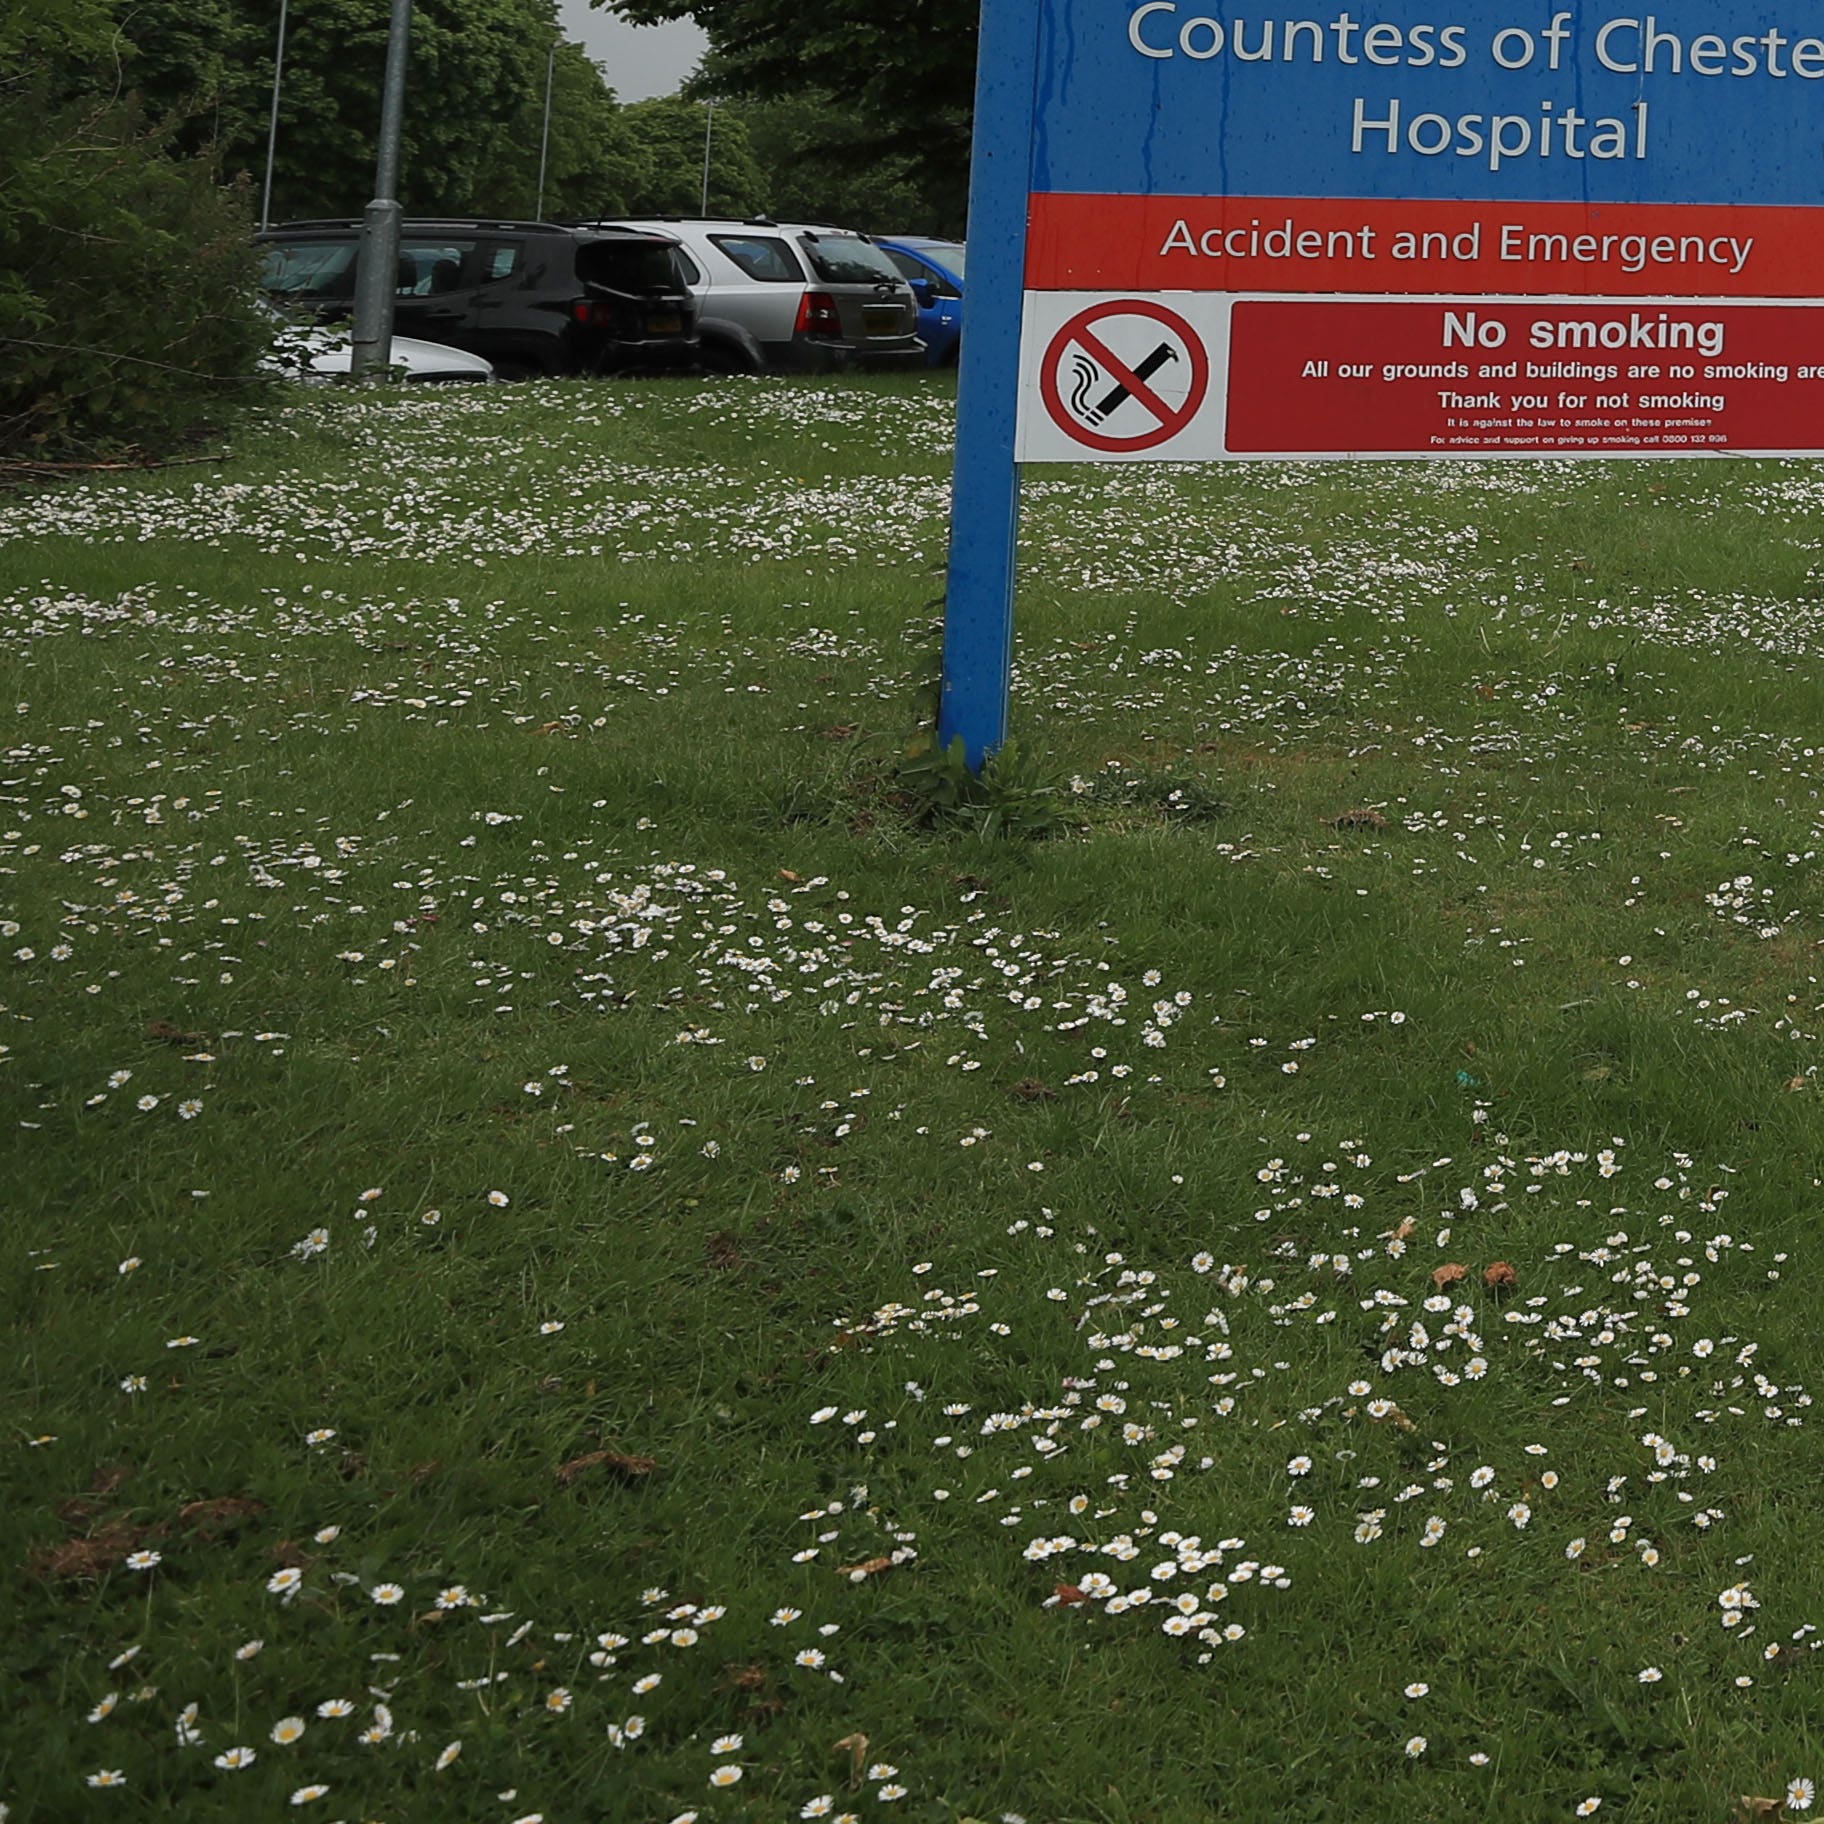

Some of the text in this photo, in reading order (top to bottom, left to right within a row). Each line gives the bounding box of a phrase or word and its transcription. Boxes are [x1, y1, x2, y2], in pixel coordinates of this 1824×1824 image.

[1128, 1, 1466, 67] Countess
[1492, 12, 1572, 69] of
[1352, 98, 1648, 171] Hospital
[1159, 219, 1754, 273] Accident and Emergency
[1443, 311, 1724, 357] No smoking
[1301, 360, 1328, 378] All
[1338, 364, 1374, 378] our
[1382, 361, 1469, 382] grounds
[1478, 361, 1517, 378] and
[1526, 361, 1618, 382] buildings
[1627, 365, 1661, 378] are
[1669, 365, 1695, 379] no
[1703, 362, 1788, 382] smoking
[1437, 391, 1725, 412] Thank you for not smoking
[1430, 435, 1445, 444] For
[1449, 435, 1480, 444] advice
[1483, 435, 1501, 444] and
[1503, 436, 1539, 445] support
[1557, 435, 1585, 445] giving
[1586, 436, 1600, 445] up
[1602, 435, 1641, 445] smoking
[1642, 435, 1660, 444] call
[1447, 418, 1455, 427] It
[1459, 418, 1469, 427] is
[1472, 417, 1513, 429] against
[1516, 418, 1534, 428] the
[1537, 417, 1556, 427] law
[1559, 418, 1572, 428] to
[1574, 417, 1611, 427] smoke
[1613, 419, 1628, 427] on
[1631, 417, 1661, 427] these
